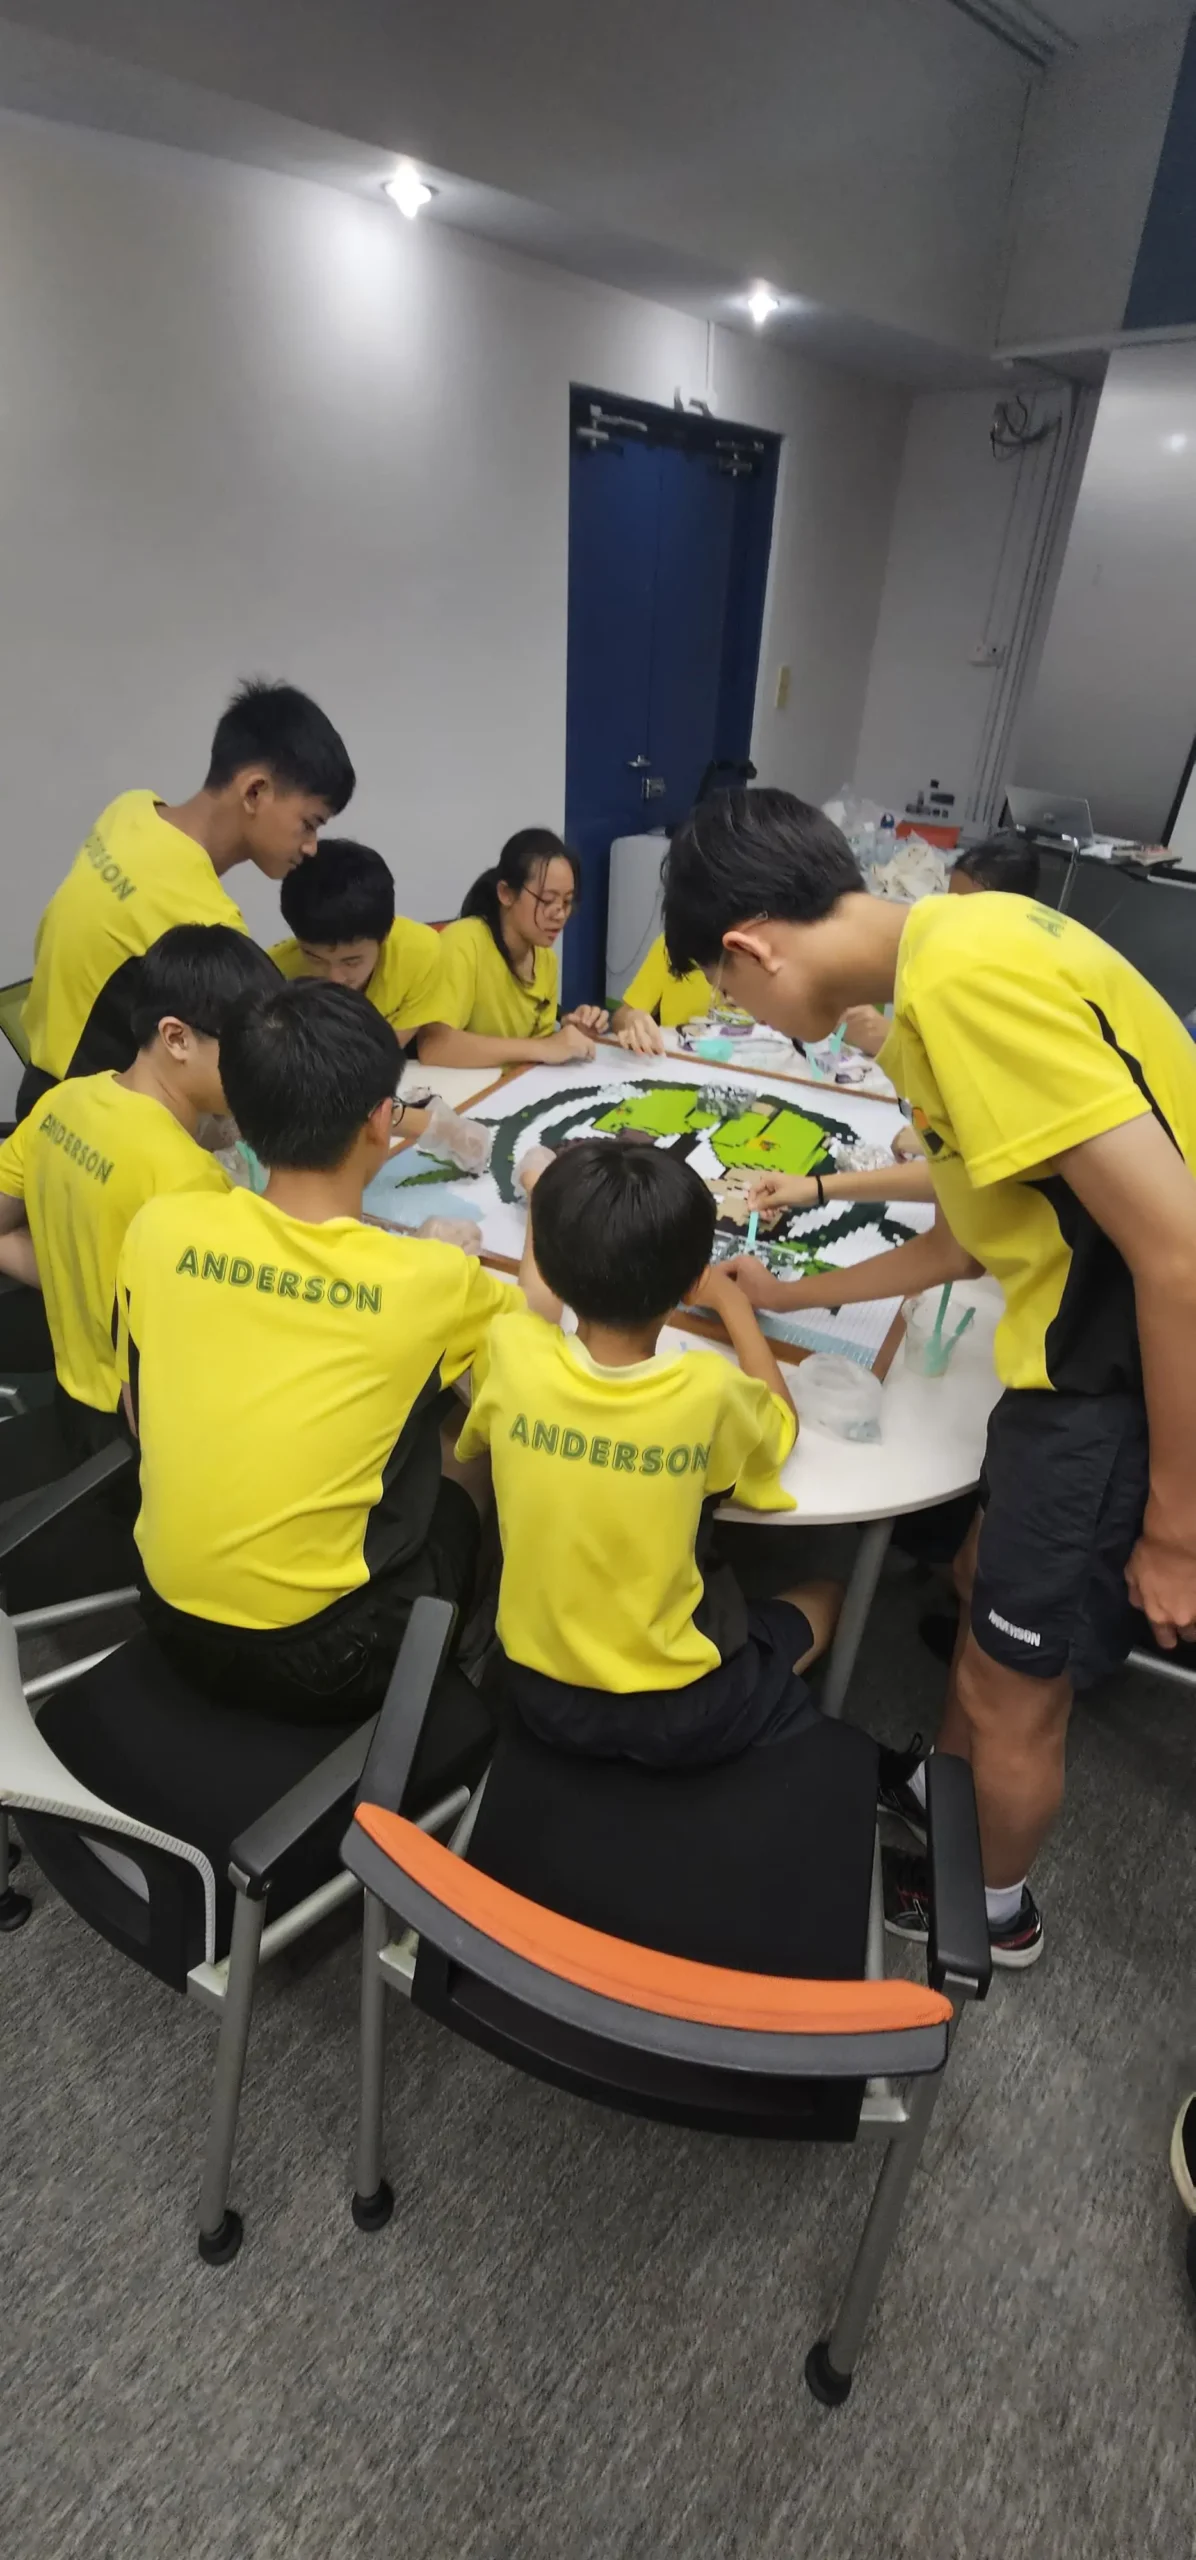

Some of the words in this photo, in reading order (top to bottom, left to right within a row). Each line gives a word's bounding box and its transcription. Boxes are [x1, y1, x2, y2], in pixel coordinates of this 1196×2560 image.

[39, 1112, 115, 1185] ANDERSON
[175, 1245, 383, 1314] ANDERSON
[509, 1413, 711, 1477] ANDERSON
